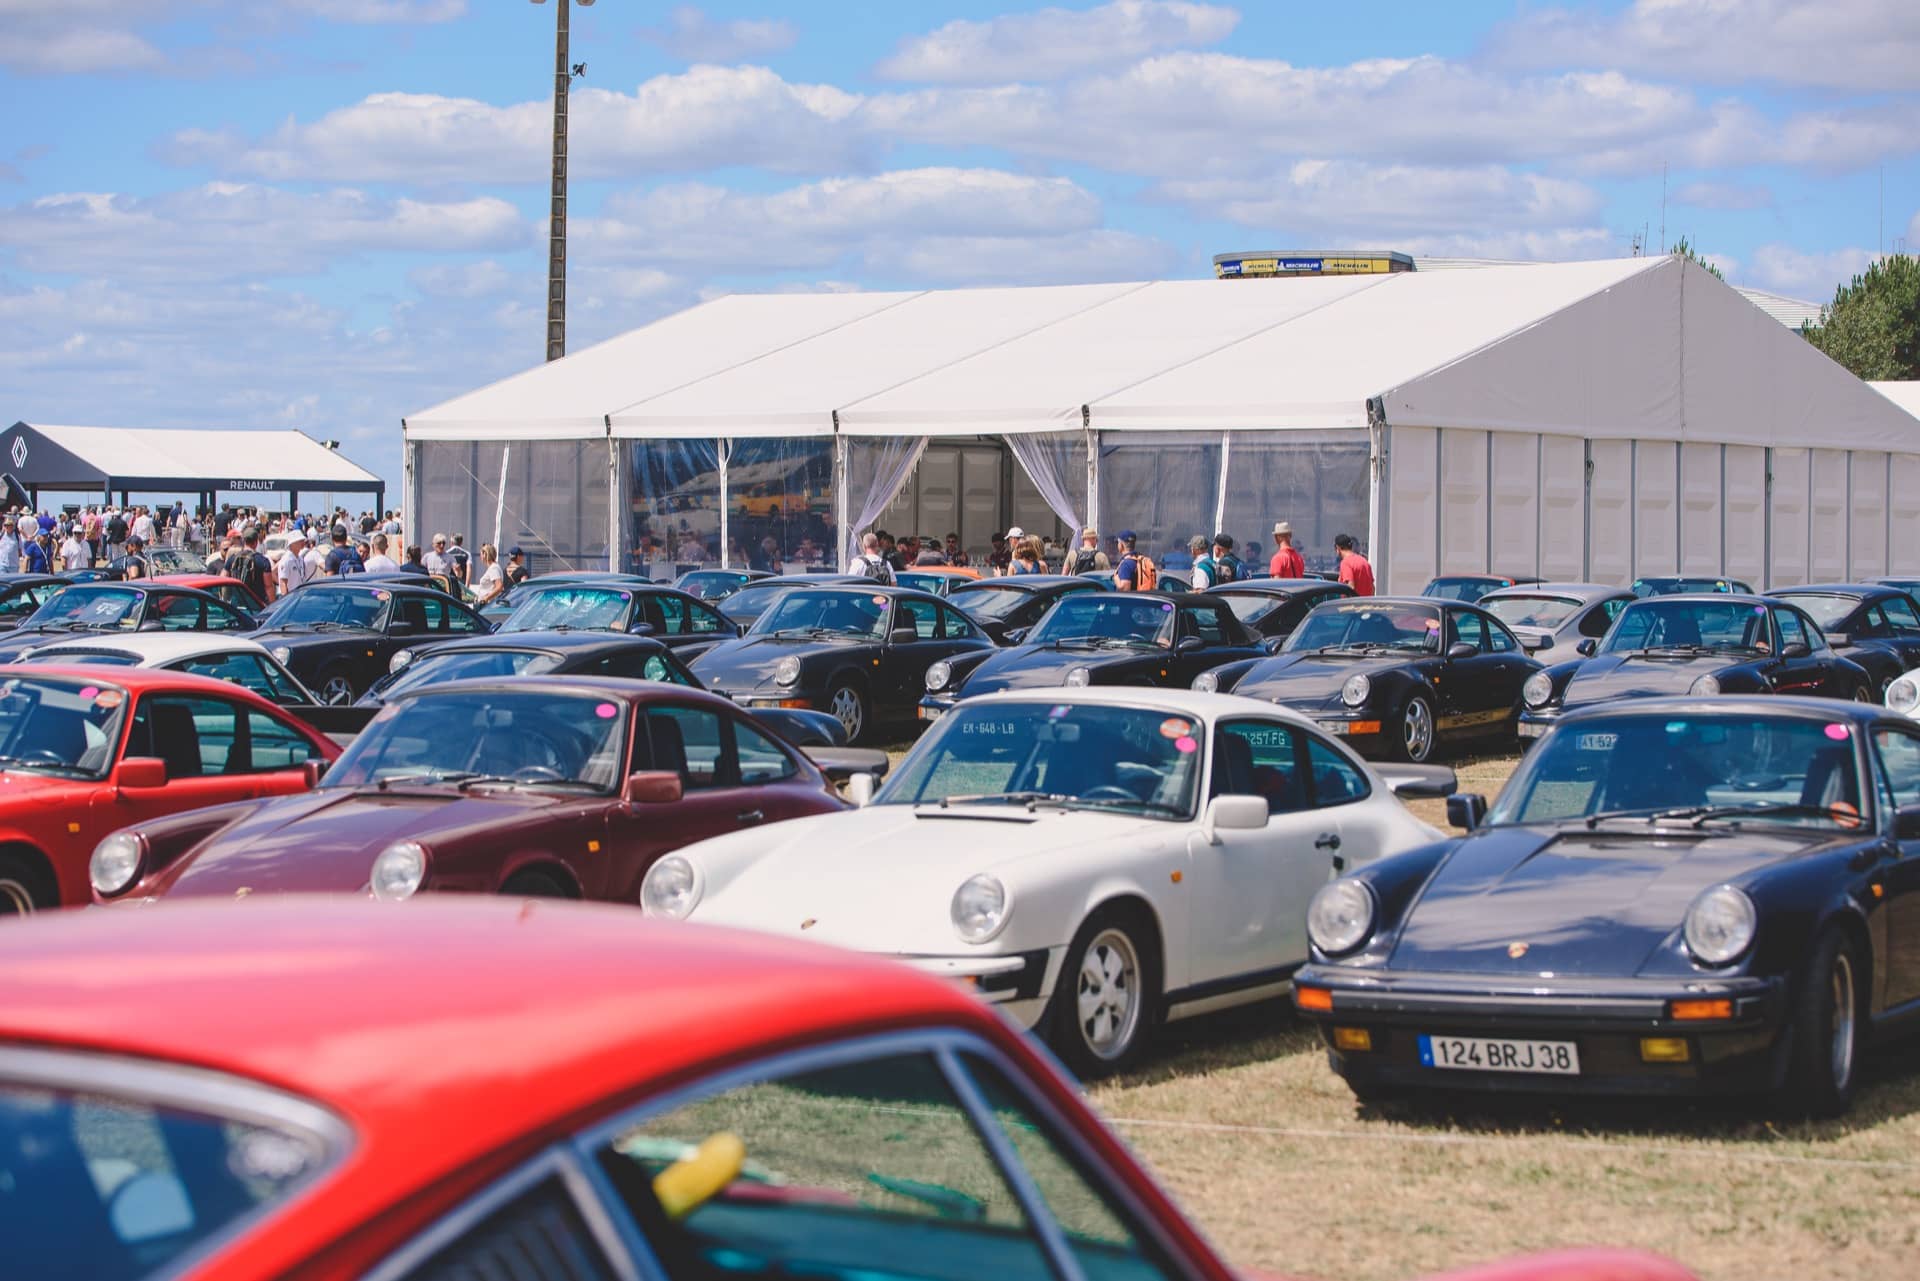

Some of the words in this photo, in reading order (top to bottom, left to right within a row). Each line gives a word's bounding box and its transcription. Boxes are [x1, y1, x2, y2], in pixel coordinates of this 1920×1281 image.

[230, 480, 275, 490] RENAULT
[1439, 1041, 1482, 1066] 124
[1487, 1043, 1535, 1068] BRJ
[1540, 1045, 1571, 1069] 38
